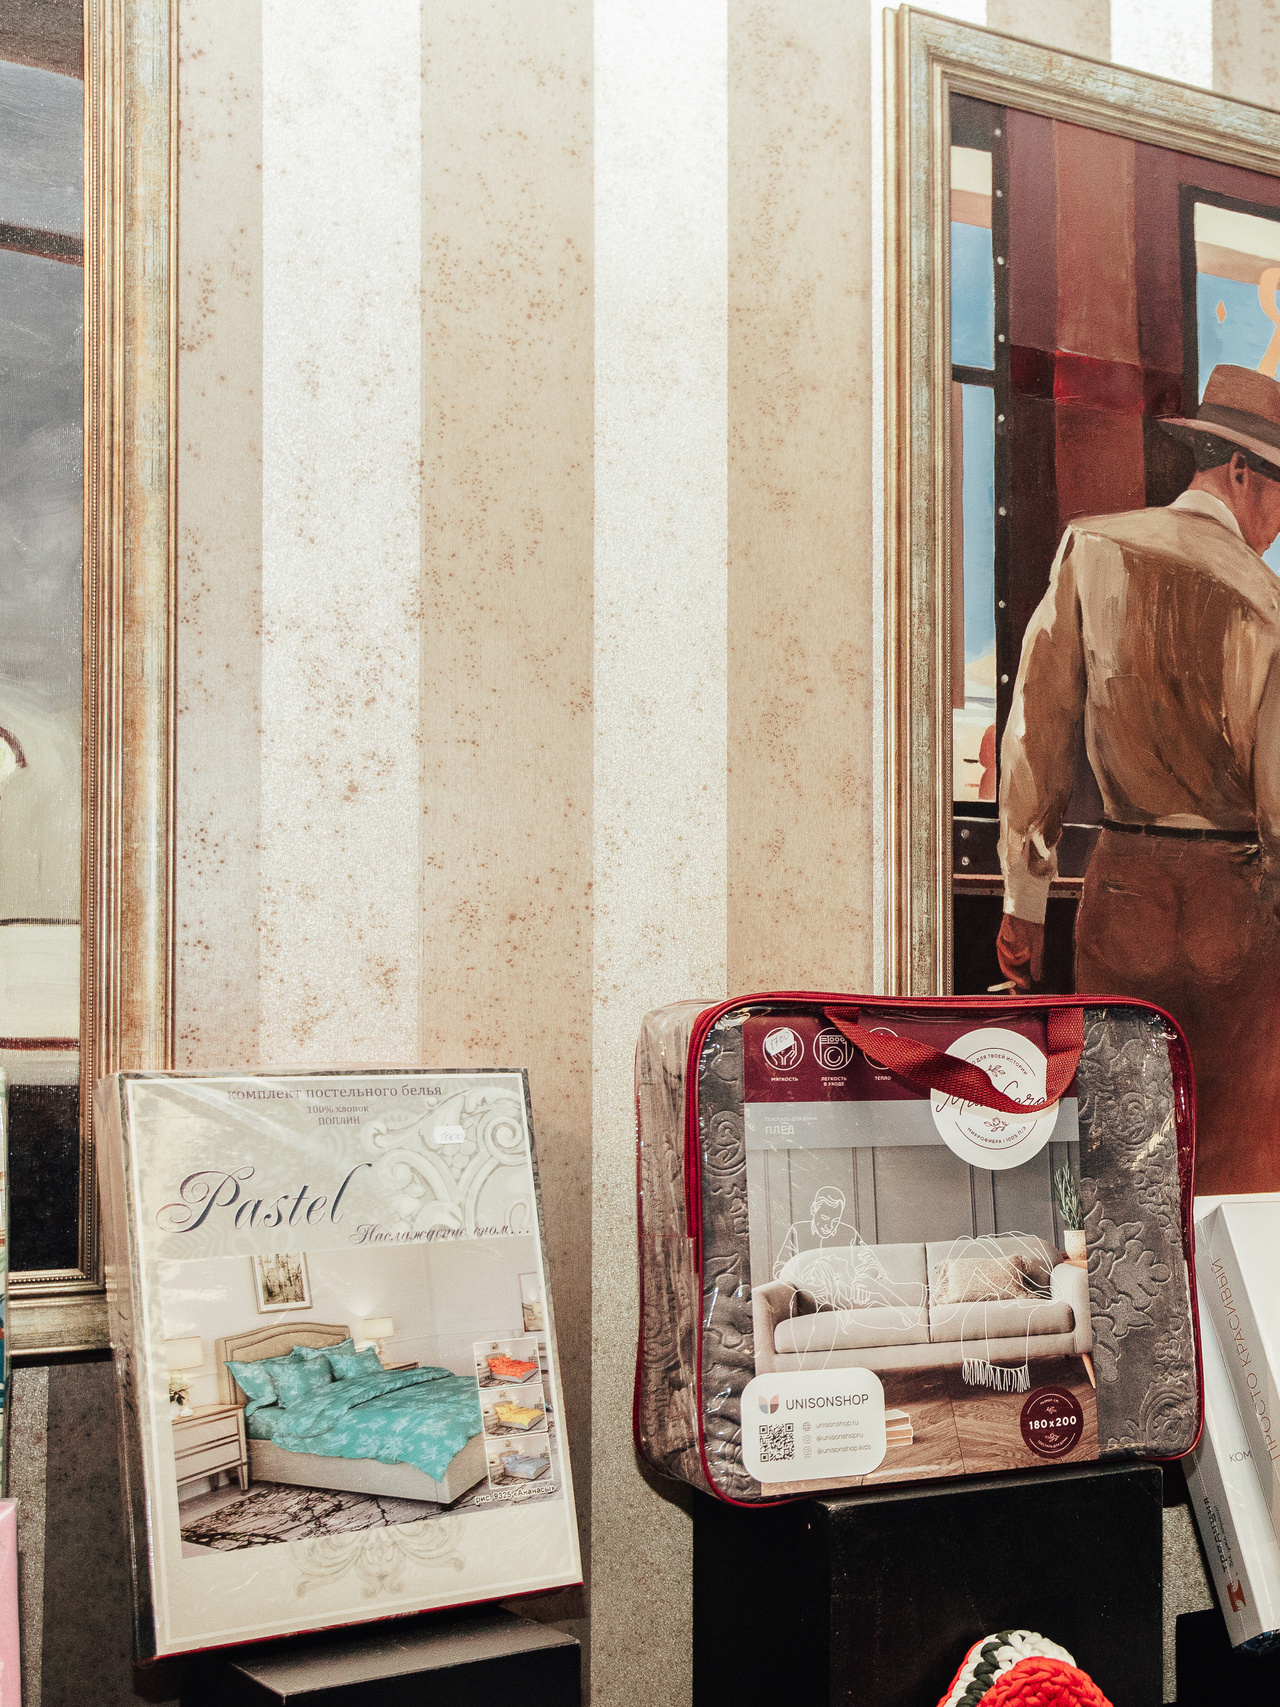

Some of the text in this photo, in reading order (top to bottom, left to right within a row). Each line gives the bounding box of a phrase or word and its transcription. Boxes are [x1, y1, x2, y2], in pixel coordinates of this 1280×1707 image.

[227, 1084, 443, 1100] комплект постельного белья
[307, 1105, 334, 1114] 100%
[765, 1125, 795, 1135] ПЛЕД
[155, 1162, 373, 1234] Pastel
[350, 1223, 467, 1245] Наслаждение
[1211, 1257, 1280, 1462] ПРОСТО КРАСИВЫЙ
[785, 1393, 870, 1411] UNISONSHOP
